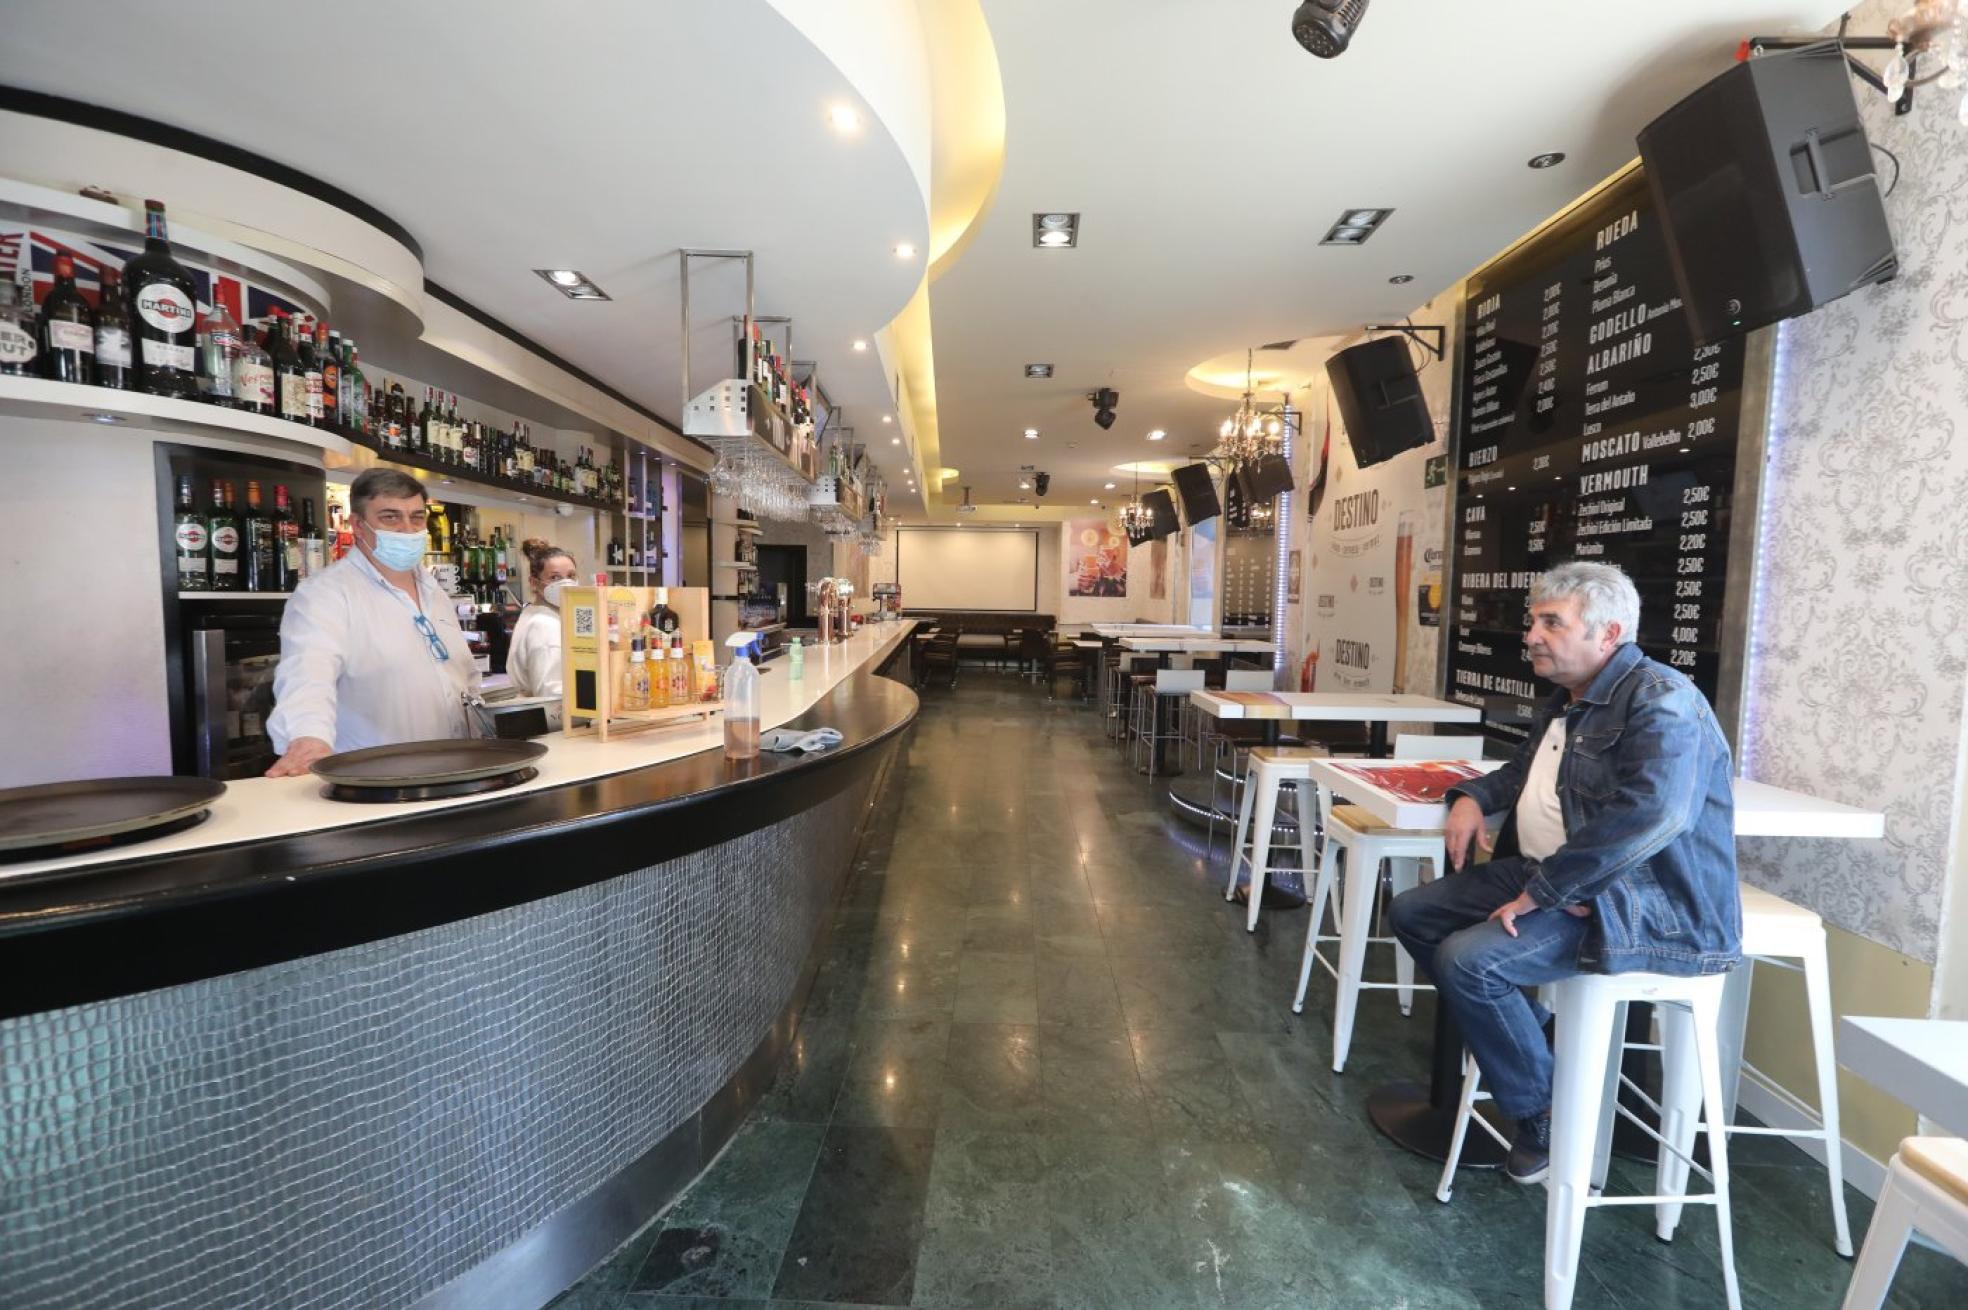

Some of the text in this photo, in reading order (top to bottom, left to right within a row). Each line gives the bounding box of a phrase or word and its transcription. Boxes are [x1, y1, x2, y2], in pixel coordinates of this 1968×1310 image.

[1596, 210, 1638, 251] RUEDA
[1589, 303, 1647, 344] GODELLO
[1586, 333, 1652, 375] ALBARIÑO
[1582, 431, 1640, 463] MOSCATO
[1580, 464, 1649, 496] VERMOUTH
[1334, 489, 1379, 531] DESTINO
[1493, 572, 1508, 588] DEL
[1335, 638, 1370, 670] DESTINO
[1495, 677, 1535, 699] CASTILLA
